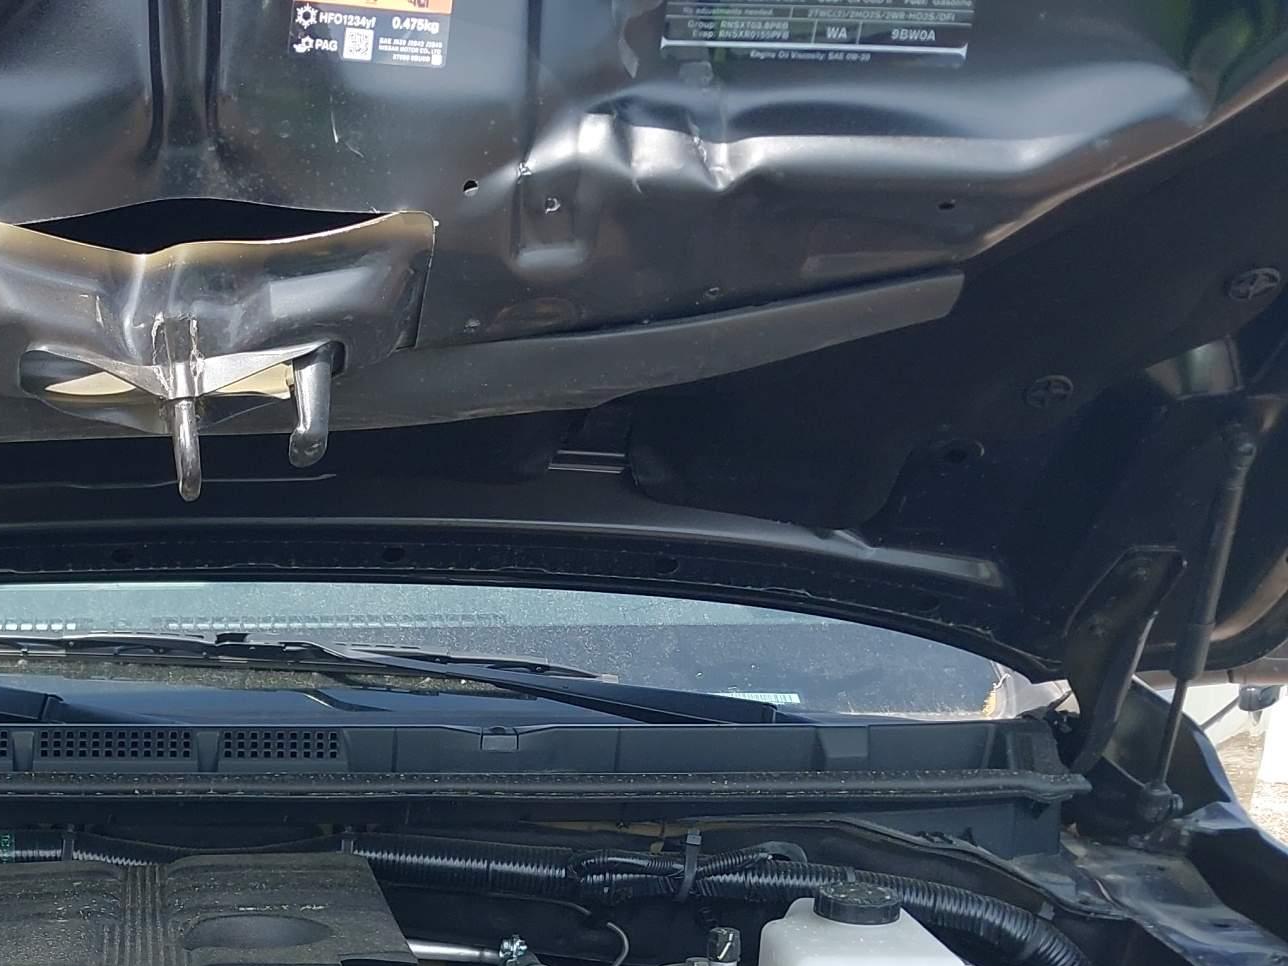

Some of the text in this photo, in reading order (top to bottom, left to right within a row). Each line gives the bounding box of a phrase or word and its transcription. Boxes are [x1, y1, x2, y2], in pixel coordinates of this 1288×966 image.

[319, 12, 377, 28] HFO1234yf
[392, 17, 440, 34] 0.475kg
[825, 26, 848, 40] WA
[315, 40, 338, 51] PAG
